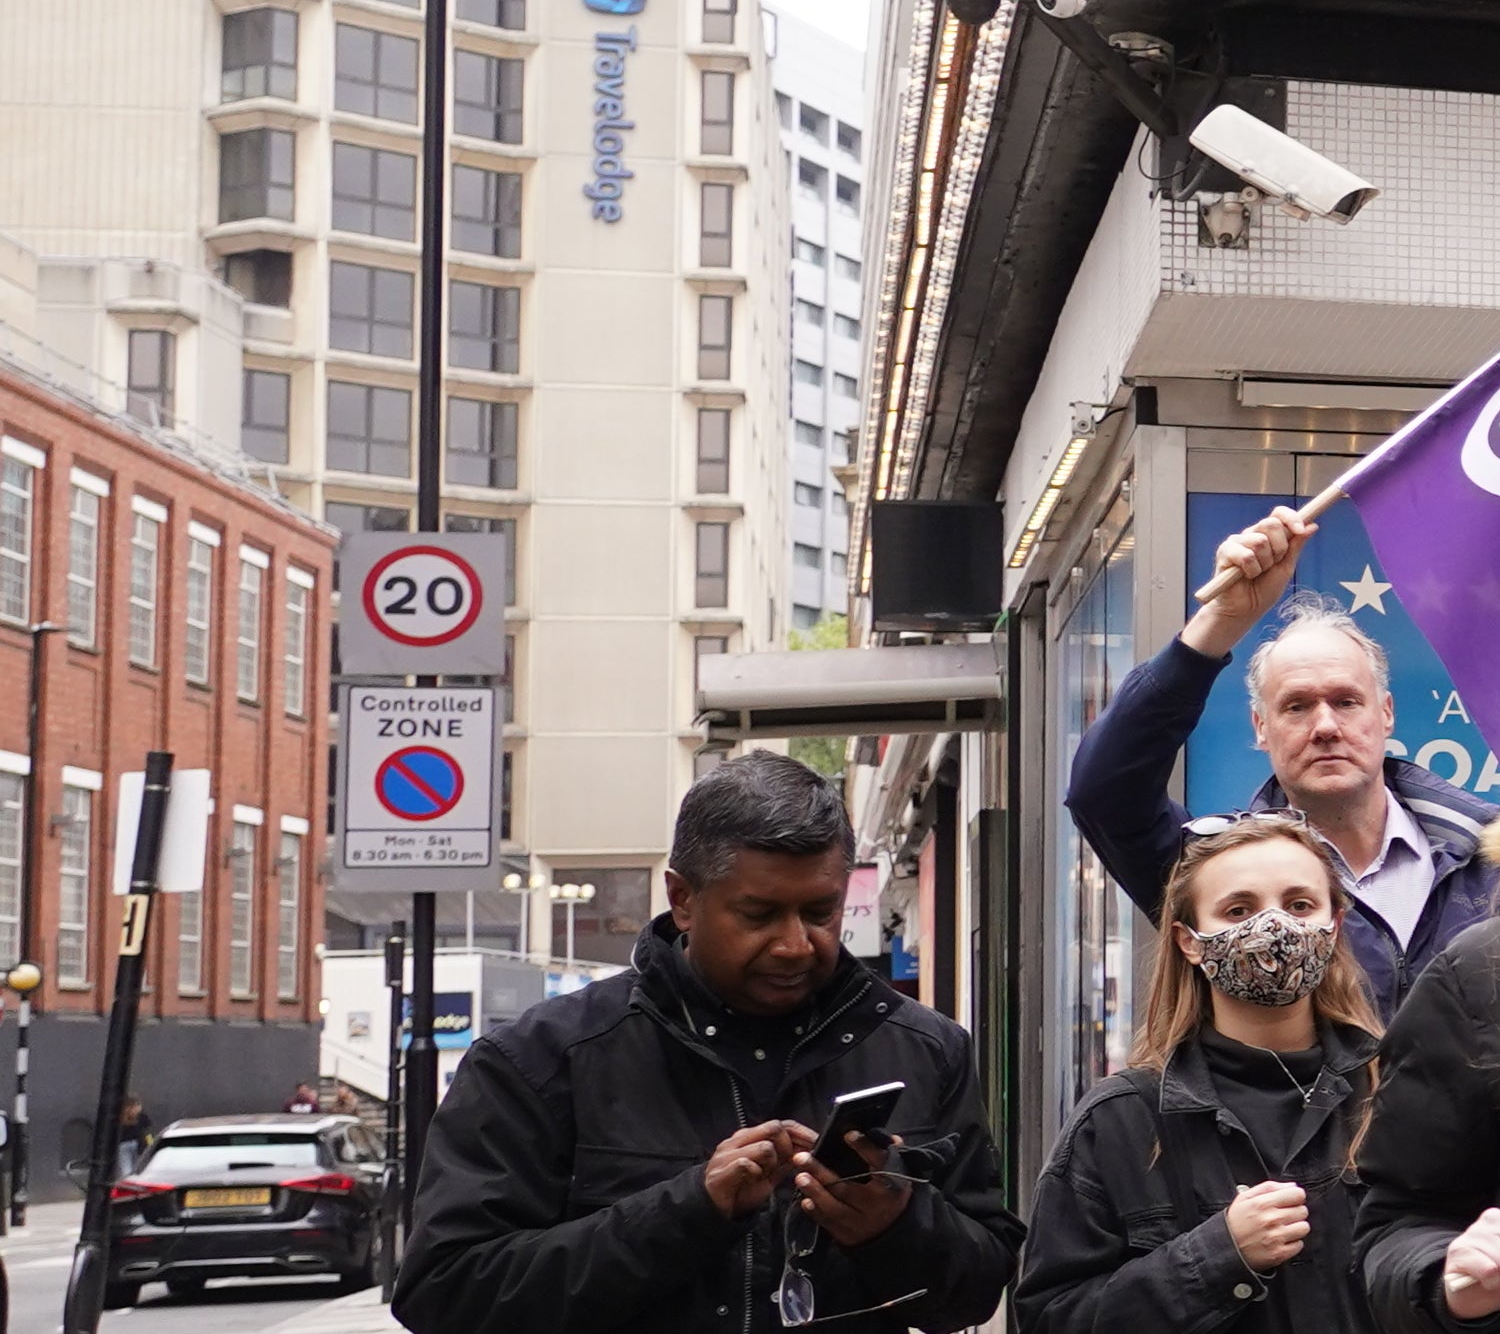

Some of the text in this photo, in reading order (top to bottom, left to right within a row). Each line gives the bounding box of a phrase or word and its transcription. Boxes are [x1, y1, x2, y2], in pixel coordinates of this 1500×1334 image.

[583, 24, 638, 224] Travelodge
[383, 576, 464, 616] 20
[360, 695, 483, 713] Controlled
[378, 718, 464, 738] ZONE
[384, 835, 452, 846] Mon Sat
[390, 853, 412, 861] am
[461, 853, 483, 862] pm
